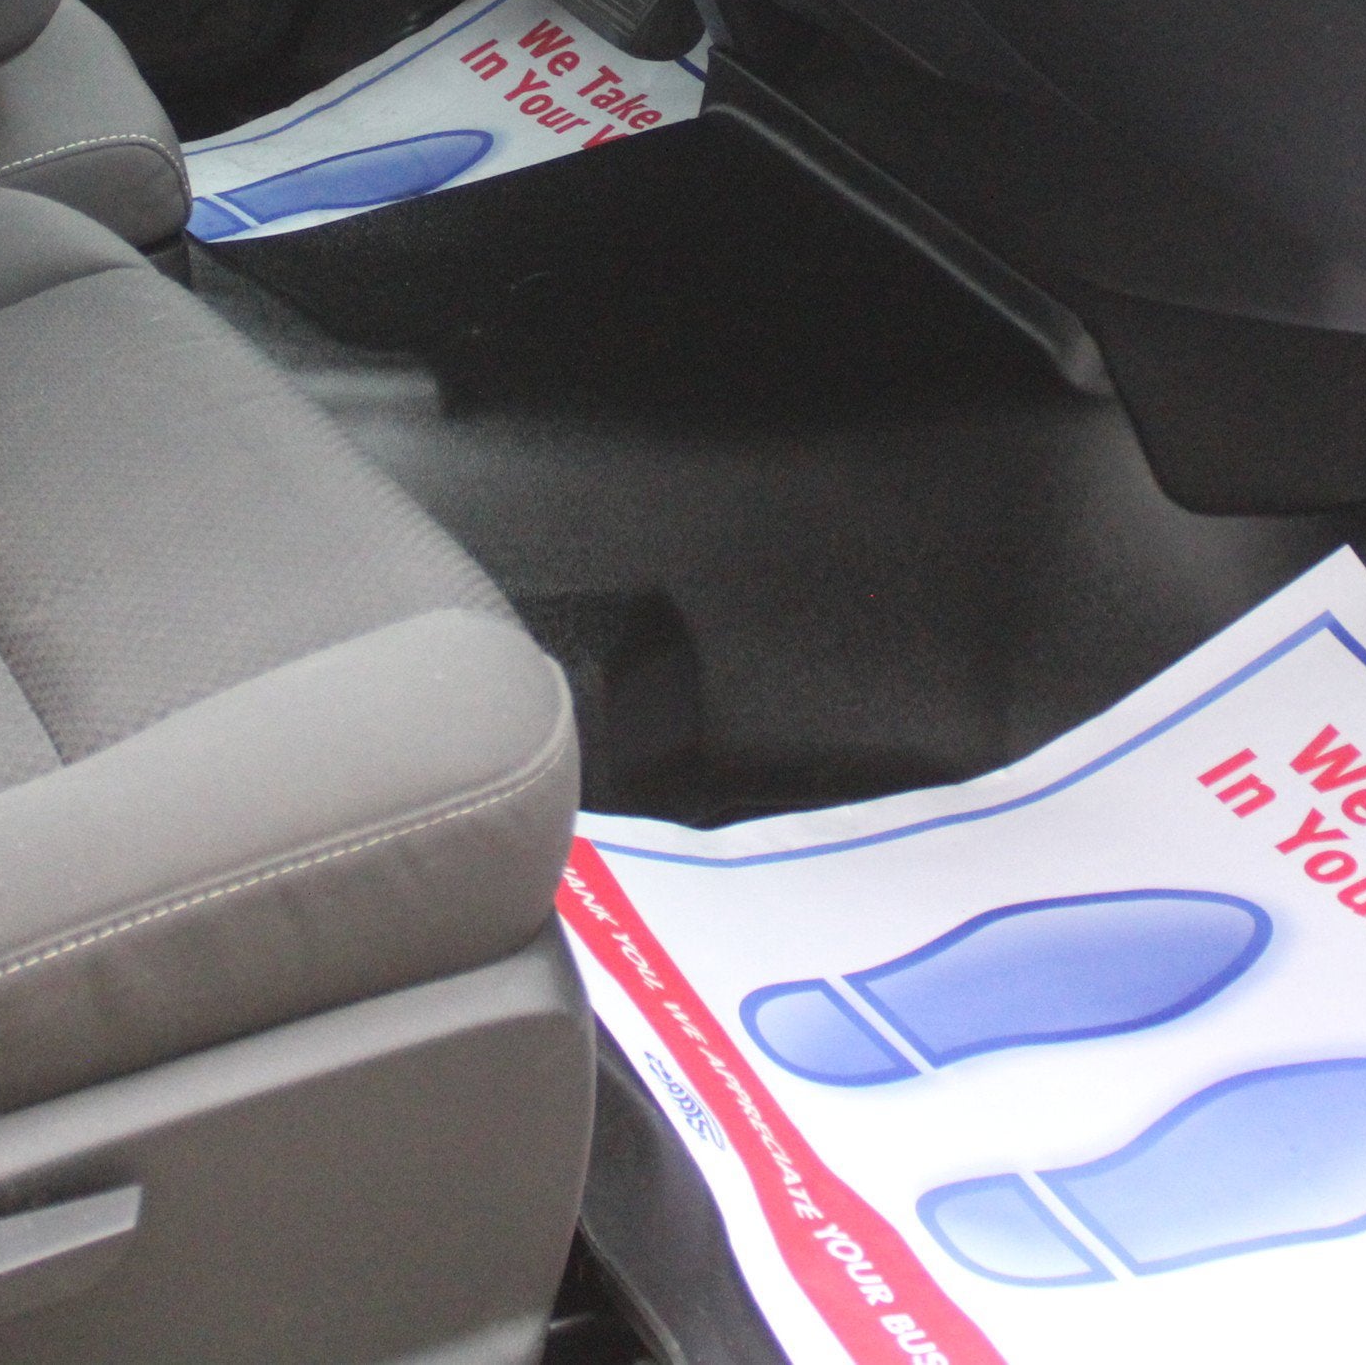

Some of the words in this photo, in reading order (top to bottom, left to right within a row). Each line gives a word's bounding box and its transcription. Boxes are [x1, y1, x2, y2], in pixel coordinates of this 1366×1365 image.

[460, 39, 508, 81] In
[504, 68, 590, 134] Your
[518, 19, 580, 76] We
[577, 65, 662, 129] Take
[1197, 747, 1277, 819] In
[663, 1001, 708, 1045] WE
[699, 1046, 824, 1221] APPRECIATE
[813, 1222, 895, 1307] YOUR
